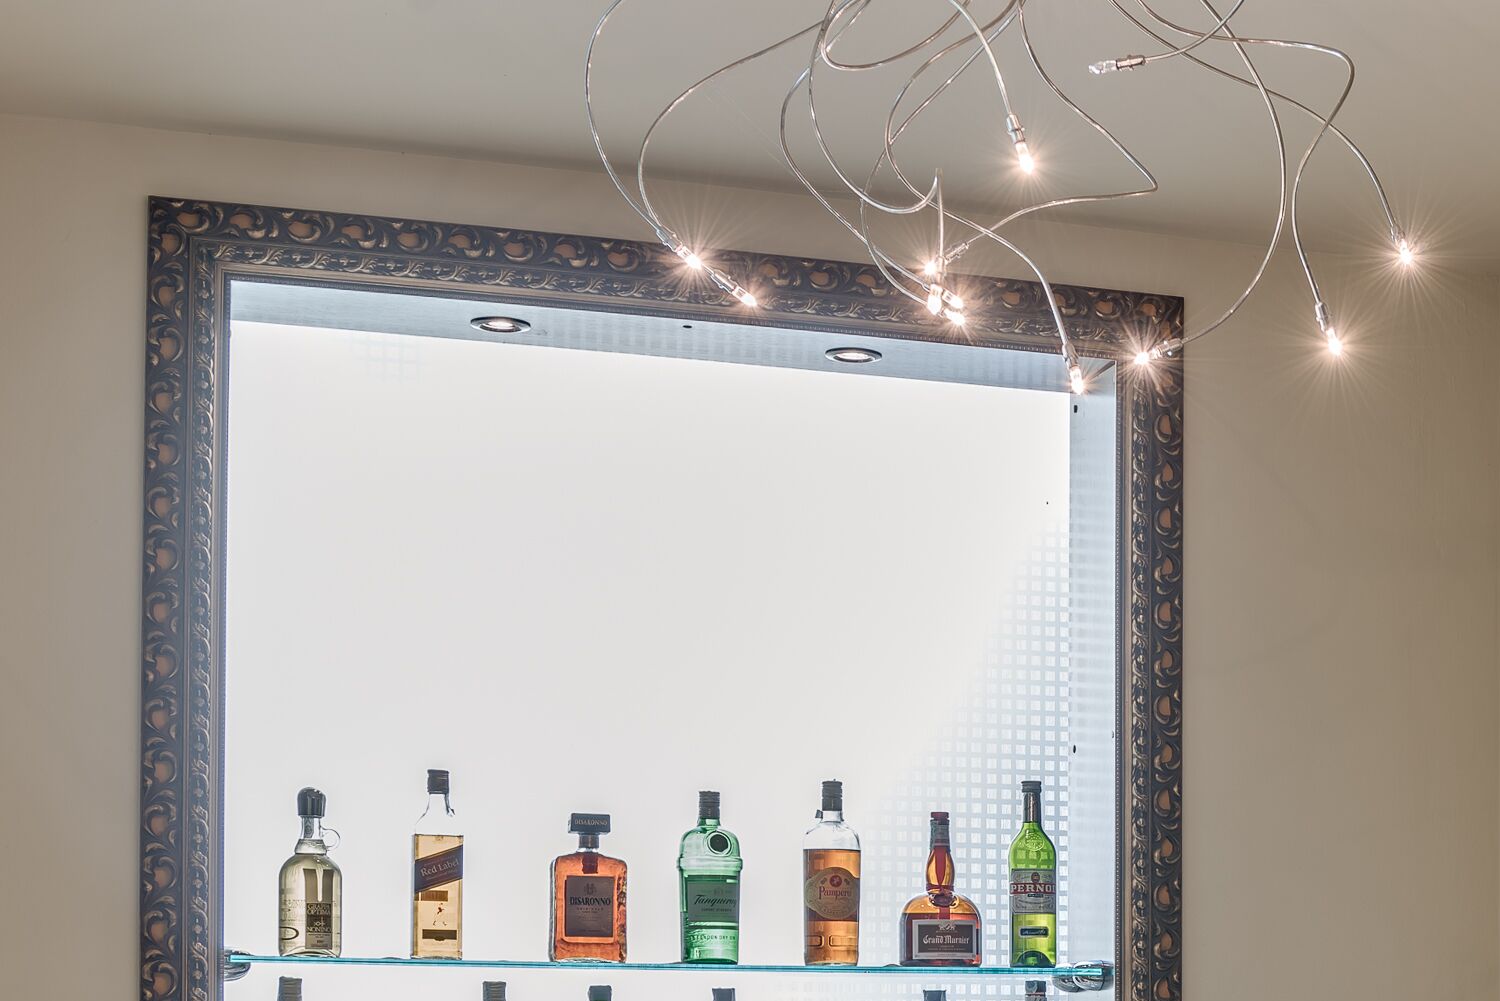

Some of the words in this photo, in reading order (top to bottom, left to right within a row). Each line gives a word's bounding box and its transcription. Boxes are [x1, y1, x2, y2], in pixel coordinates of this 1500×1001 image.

[420, 865, 438, 877] Red
[438, 858, 459, 871] Label
[569, 896, 611, 906] DISARONNO
[923, 934, 944, 945] Grand
[944, 934, 970, 945] Marnier
